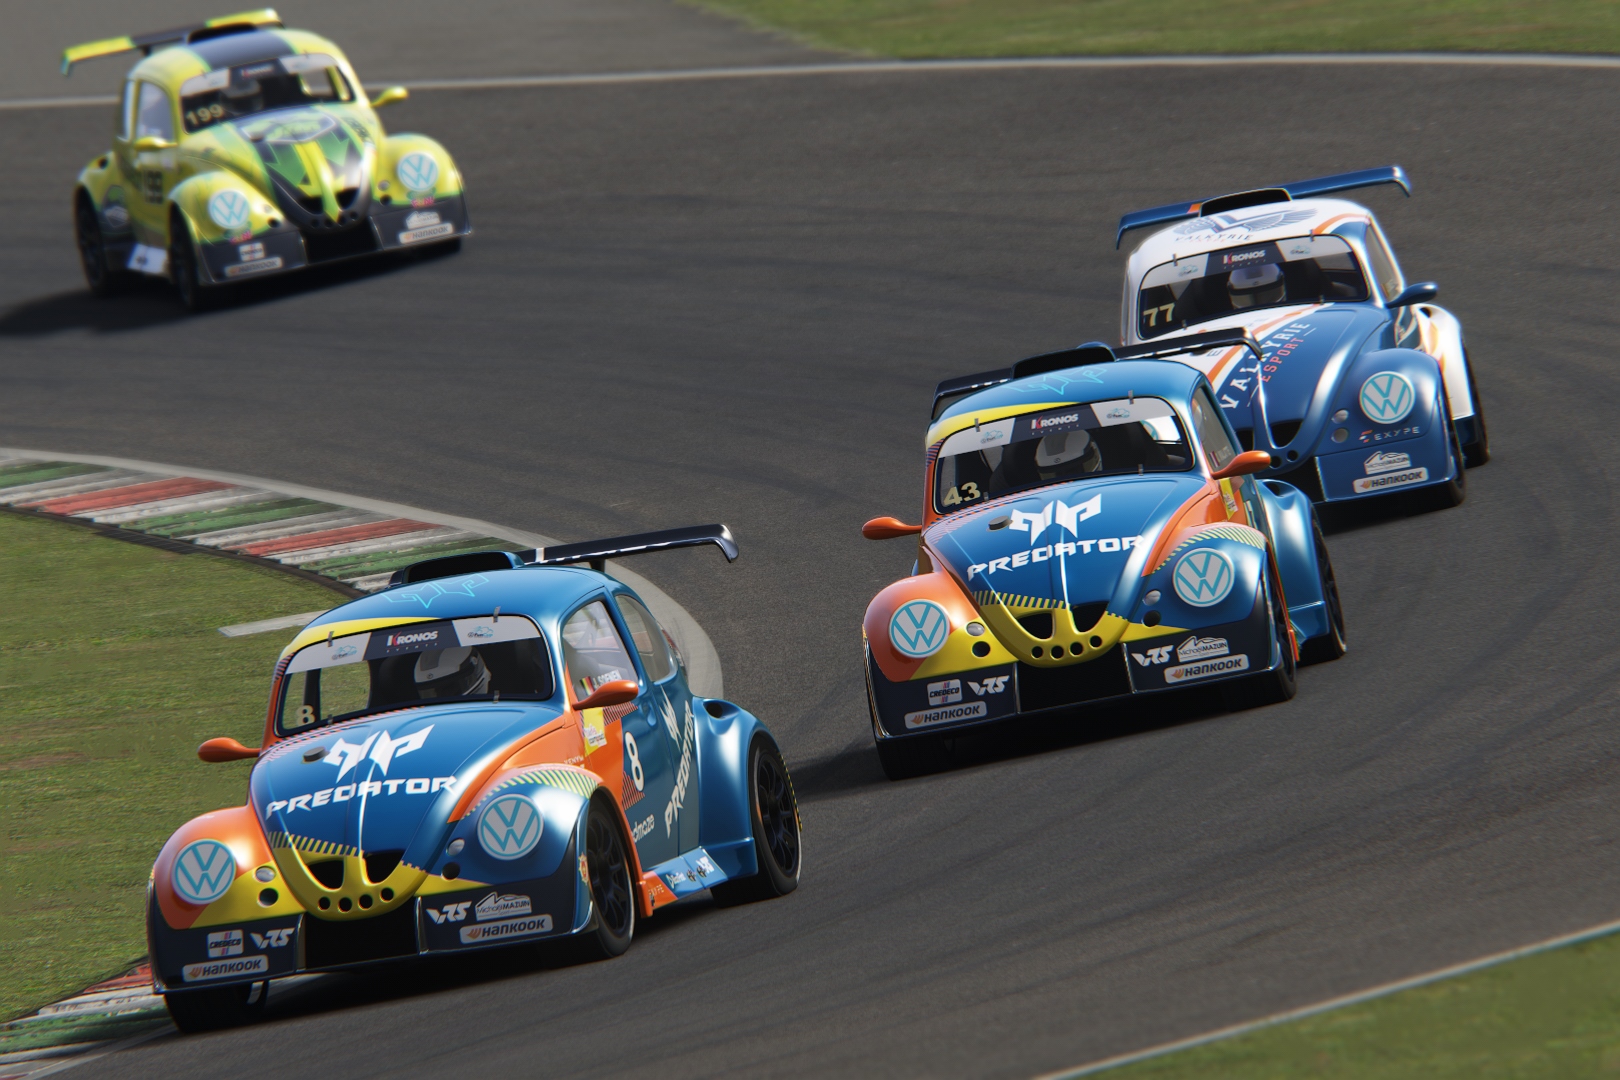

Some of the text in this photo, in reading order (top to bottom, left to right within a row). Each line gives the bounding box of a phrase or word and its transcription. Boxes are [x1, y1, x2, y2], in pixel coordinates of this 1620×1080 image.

[186, 103, 224, 126] 199
[1223, 250, 1266, 264] KRONOS
[1143, 303, 1175, 327] 77
[1031, 413, 1079, 430] KRONOS
[943, 481, 981, 506] 43
[966, 535, 1146, 582] PREDATOR
[387, 631, 439, 646] KRONOS
[929, 687, 960, 699] CREDECO
[295, 705, 316, 727] 8
[625, 732, 644, 792] 8
[266, 775, 457, 821] PREDATOR
[209, 938, 242, 949] CREDECO
